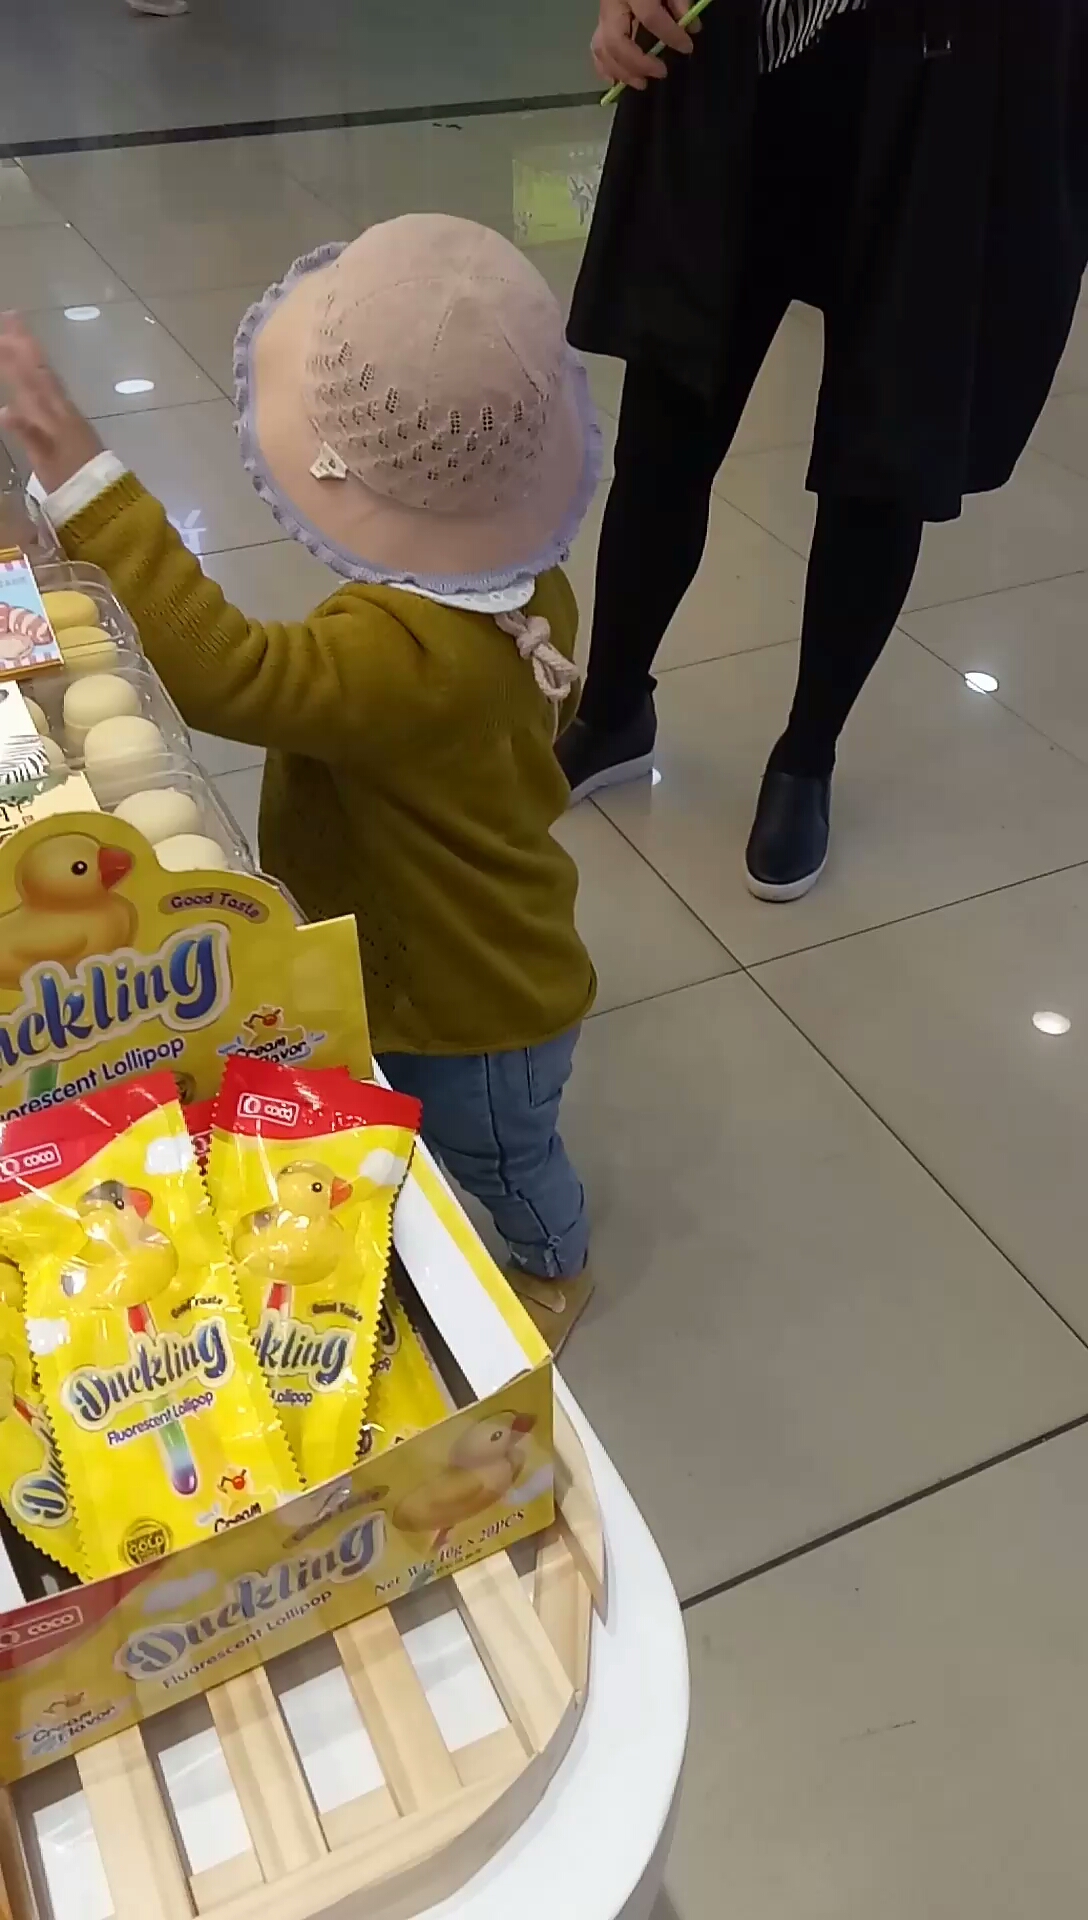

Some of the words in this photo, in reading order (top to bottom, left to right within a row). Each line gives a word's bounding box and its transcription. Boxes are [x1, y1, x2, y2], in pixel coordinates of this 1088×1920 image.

[171, 894, 213, 909] Good
[219, 893, 261, 918] Taste
[0, 934, 217, 1067] uckling
[0, 1069, 97, 1120] orescent
[102, 1038, 184, 1080] Lollipop
[73, 1323, 226, 1422] Duckling
[251, 1320, 349, 1385] kling
[107, 1406, 172, 1445] Fluorescent
[126, 1518, 375, 1673] Duckling
[162, 1629, 263, 1690] Fluorescent
[267, 1589, 333, 1631] Lollipop
